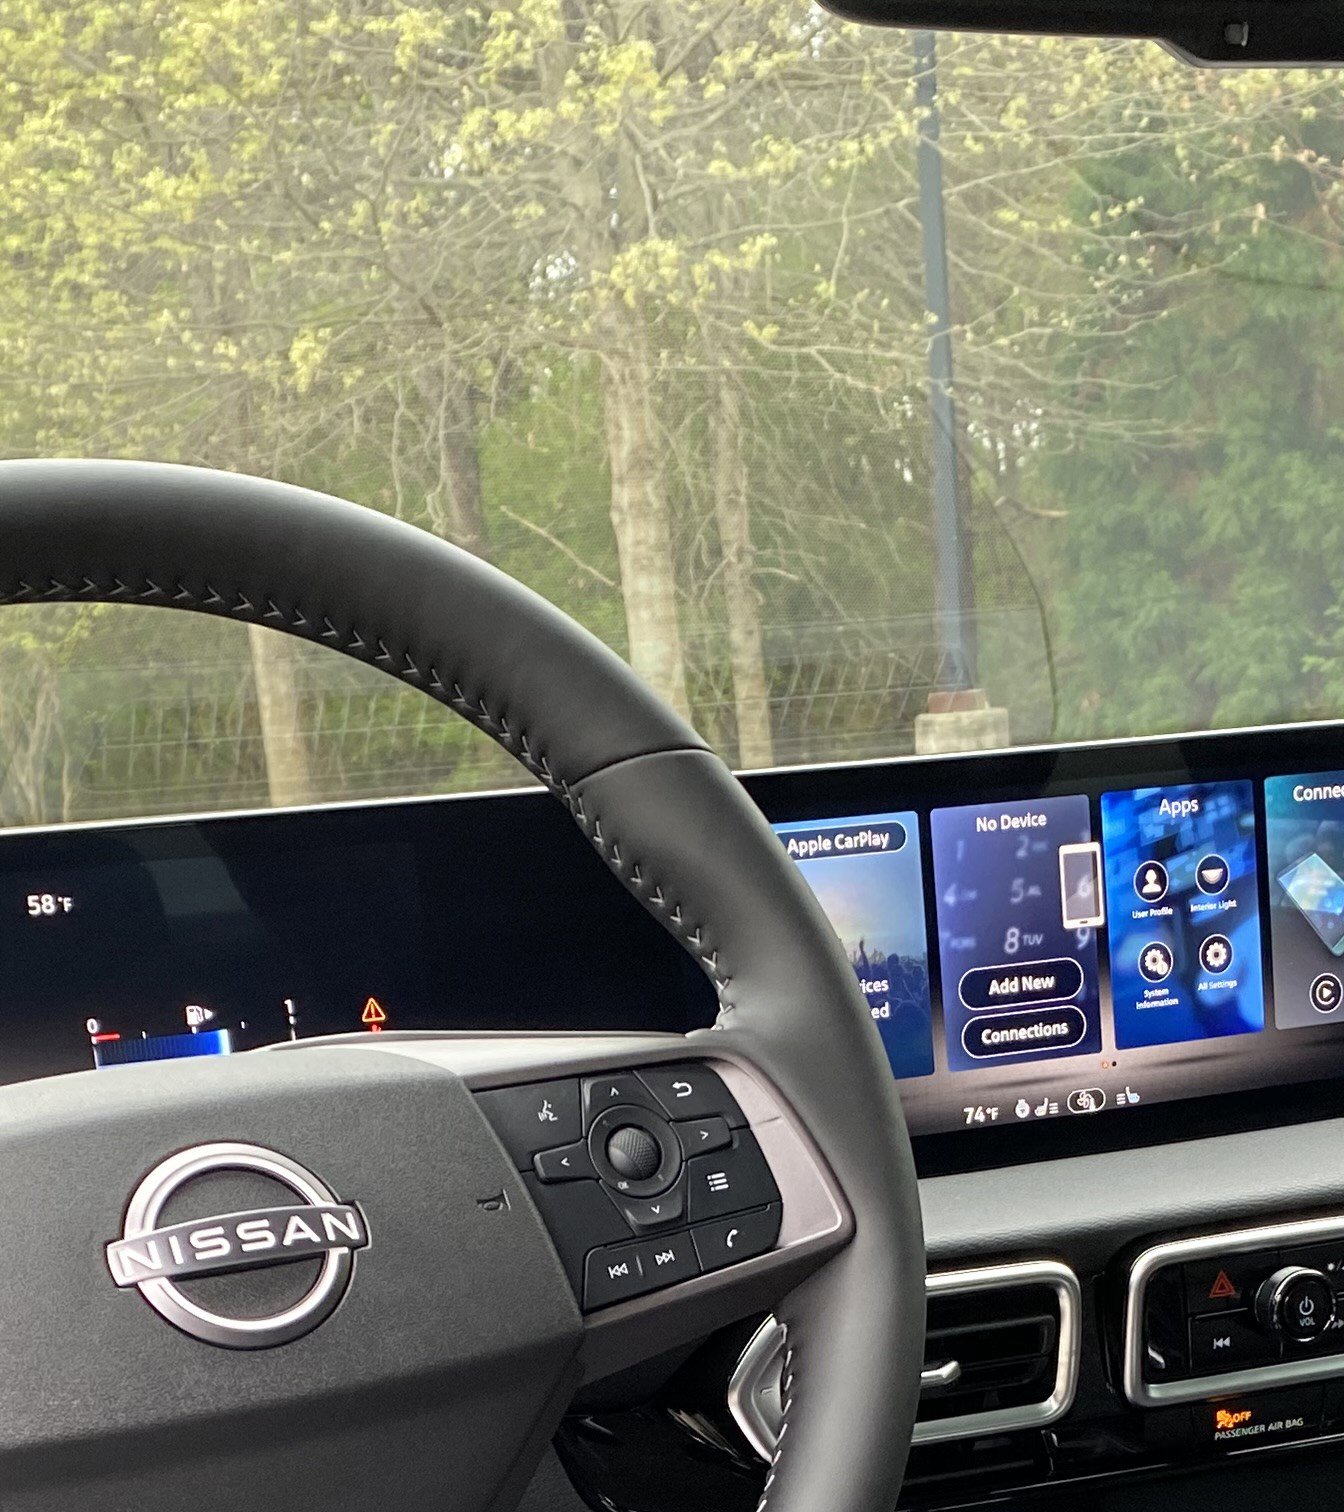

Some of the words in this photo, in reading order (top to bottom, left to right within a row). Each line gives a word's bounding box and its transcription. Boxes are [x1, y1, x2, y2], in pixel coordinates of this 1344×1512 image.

[1158, 798, 1199, 818] Apps
[975, 816, 998, 833] No
[1000, 812, 1048, 831] Device
[787, 834, 832, 858] Apple
[834, 829, 890, 850] CarPlay
[1131, 909, 1149, 920] User
[1149, 906, 1174, 917] Profile
[1190, 901, 1218, 913] Interior
[1218, 899, 1238, 911] Light
[1003, 925, 1020, 955] 8
[859, 978, 890, 994] ices
[988, 976, 1019, 996] Add
[1021, 975, 1055, 991] New
[1209, 979, 1238, 990] Settings
[1143, 988, 1170, 1000] System
[1136, 997, 1179, 1010] Information
[981, 1022, 1070, 1045] Connections
[116, 1210, 362, 1279] NISSAN
[1299, 1316, 1316, 1327] VOL
[1233, 1410, 1252, 1424] OFF
[1214, 1423, 1266, 1440] PASSENGER
[1267, 1420, 1284, 1432] AIR
[1285, 1417, 1304, 1429] BAG
